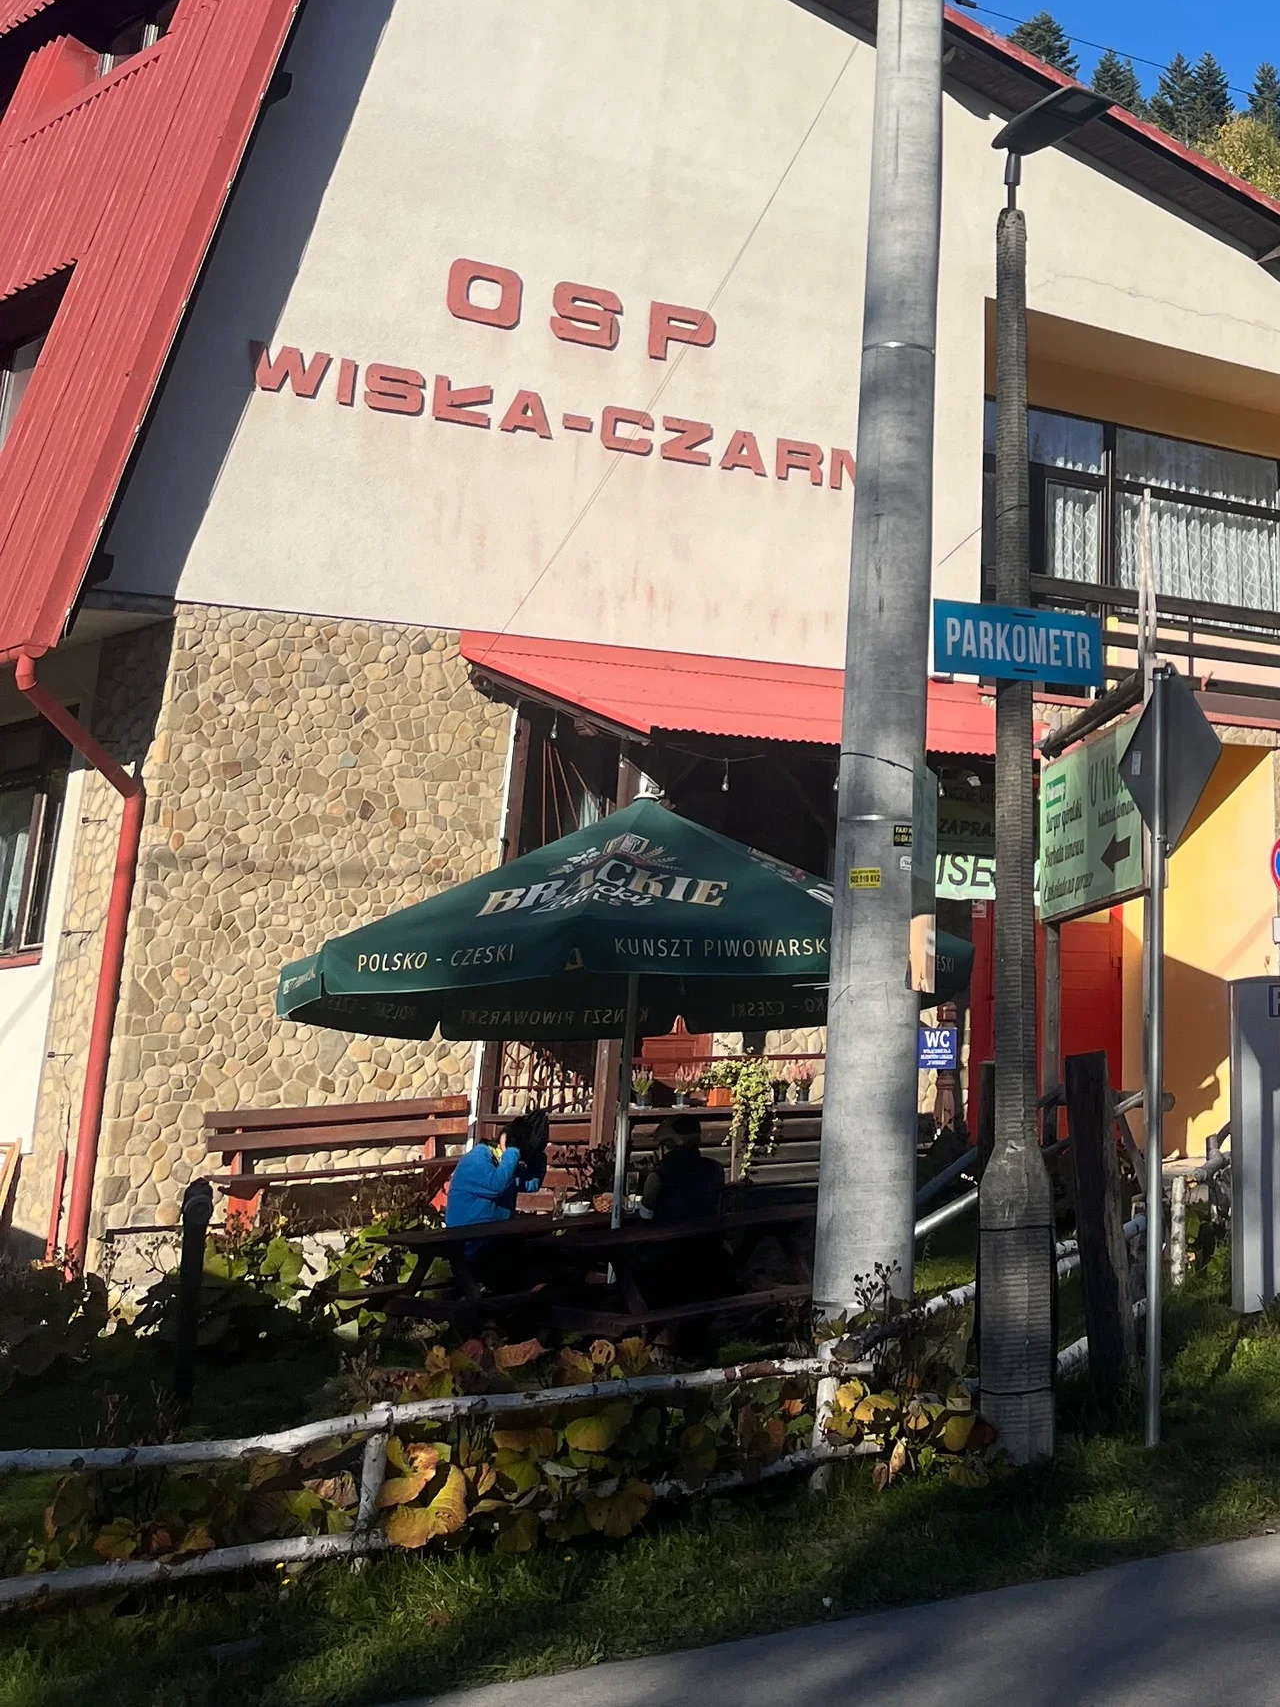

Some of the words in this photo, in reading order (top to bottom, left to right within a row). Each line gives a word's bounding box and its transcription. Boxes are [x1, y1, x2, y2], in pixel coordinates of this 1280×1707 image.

[446, 257, 718, 361] OSP
[249, 339, 857, 490] WISŁA-CZARN
[945, 617, 1092, 670] PARKOMETR
[474, 859, 729, 918] BRACKIE
[357, 951, 428, 973] POLSKO
[450, 943, 515, 968] CZESKI
[614, 937, 695, 958] KUNSZT
[704, 937, 828, 958] PIWOWARSK
[924, 1030, 950, 1048] WC
